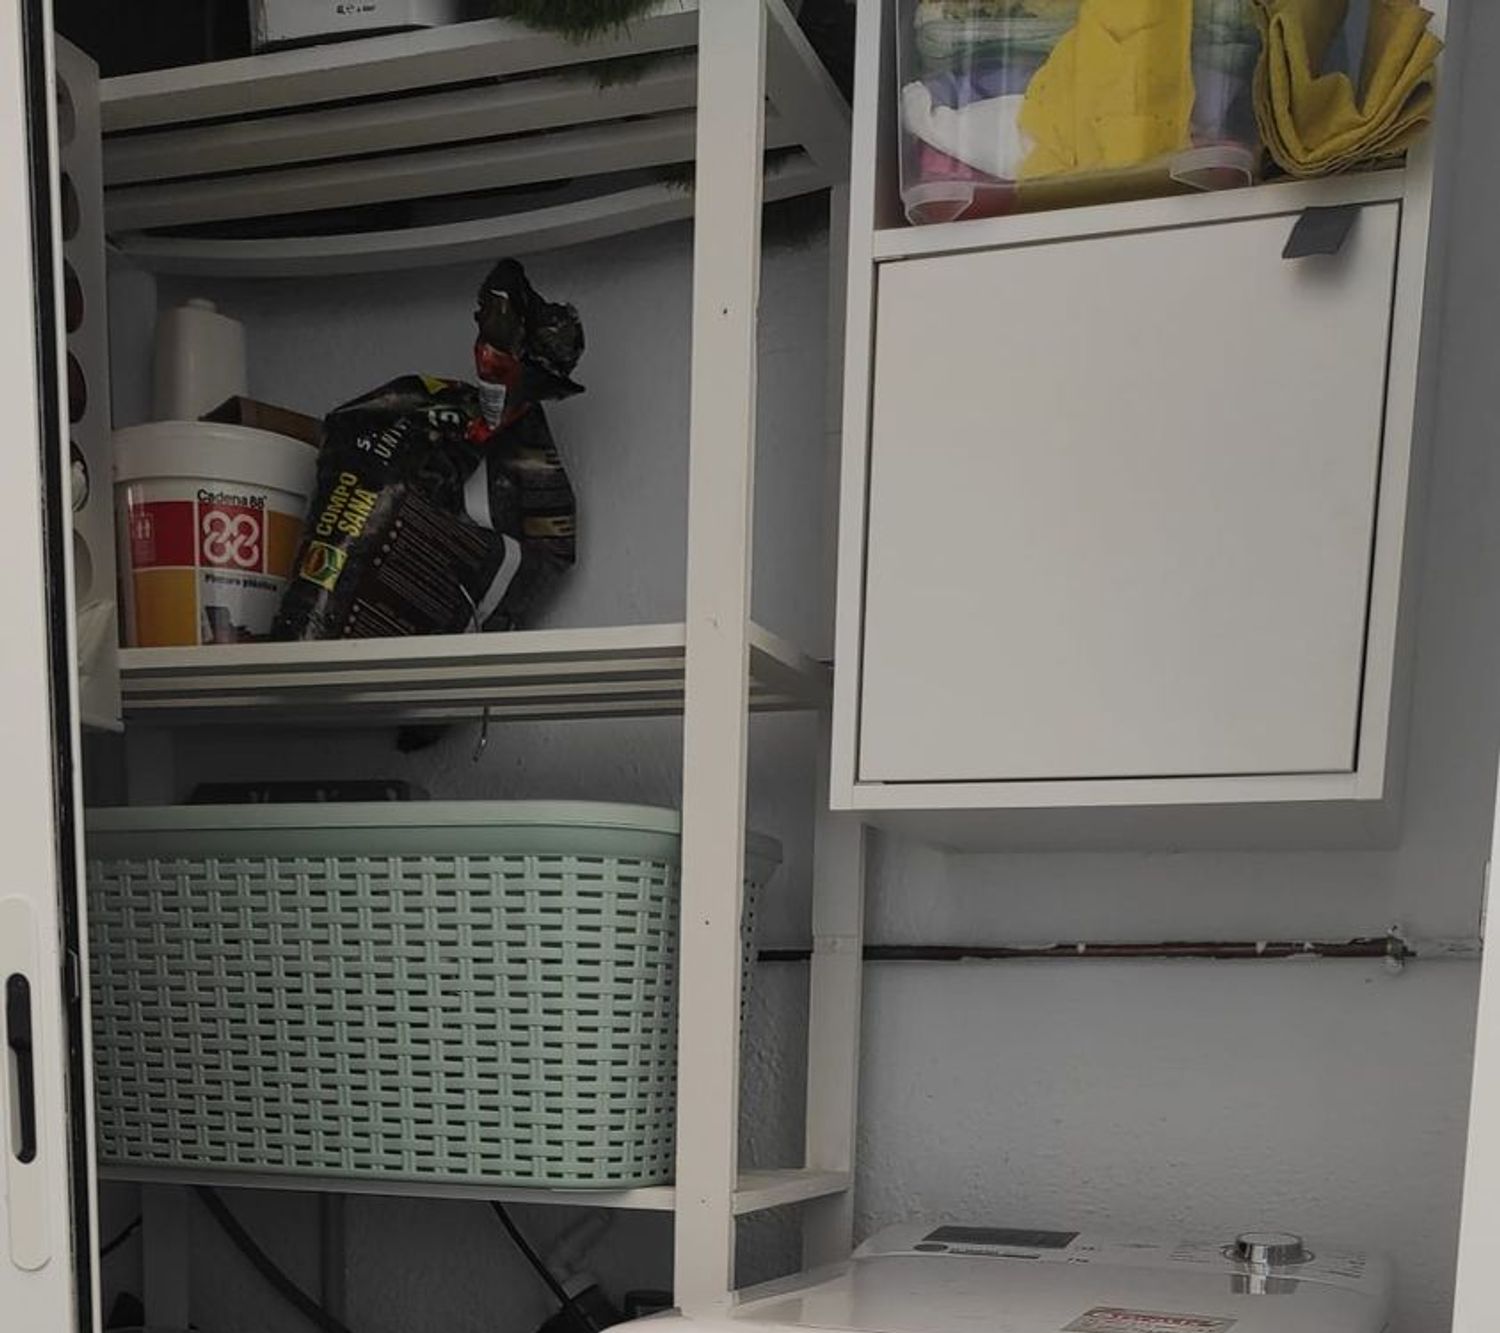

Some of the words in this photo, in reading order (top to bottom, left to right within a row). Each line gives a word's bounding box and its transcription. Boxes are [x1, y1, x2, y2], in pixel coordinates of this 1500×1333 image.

[197, 489, 248, 506] Cadena
[316, 472, 358, 536] COMPO
[337, 487, 379, 537] SANA
